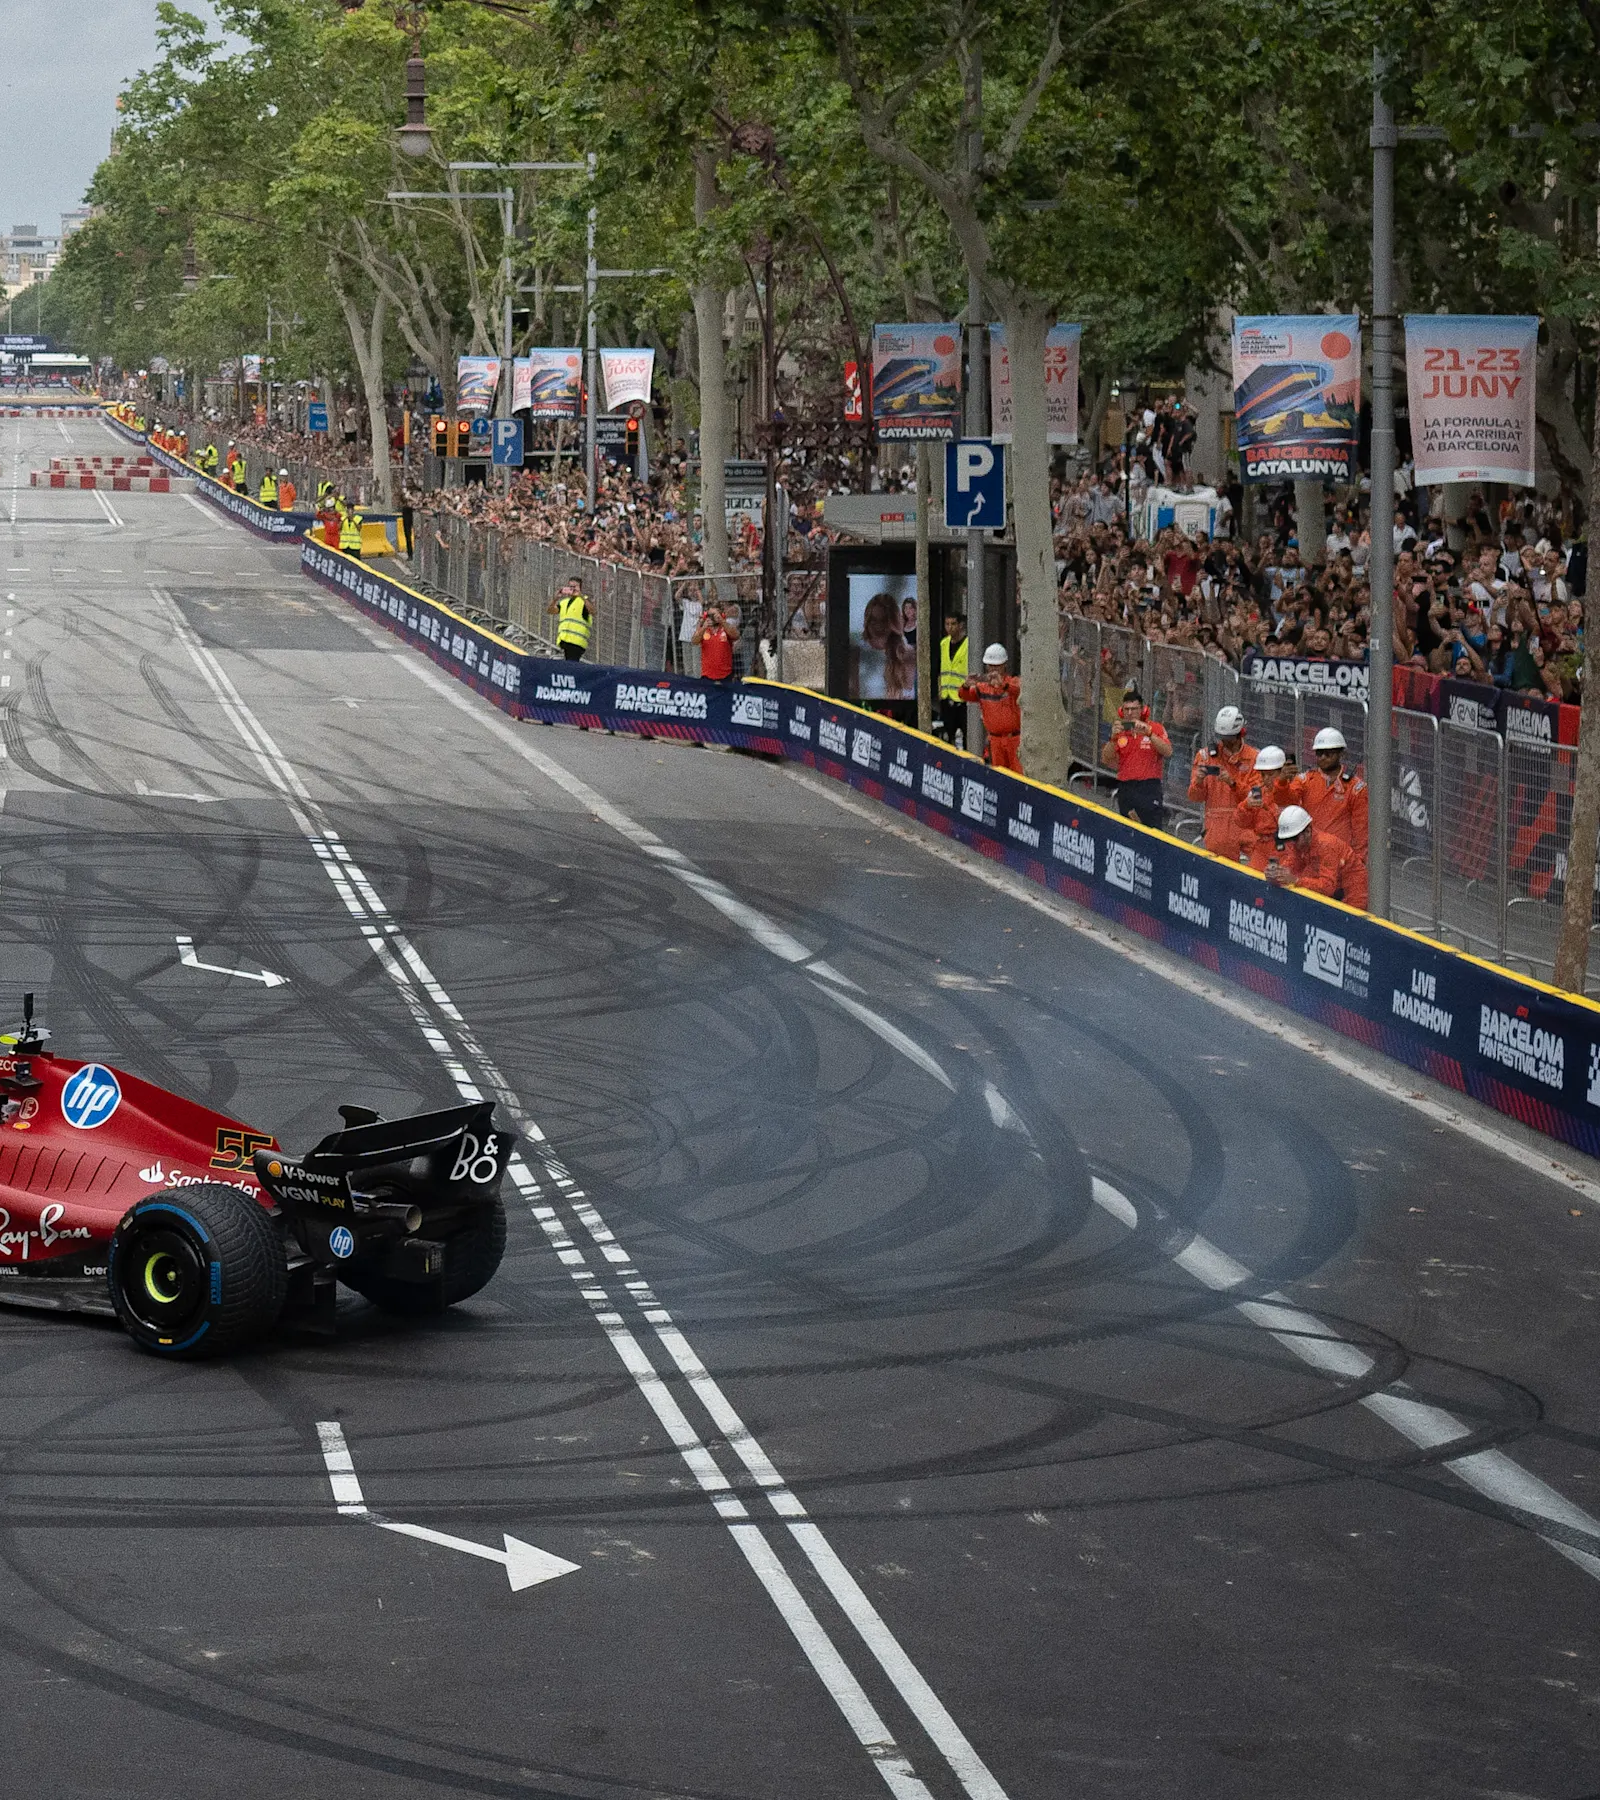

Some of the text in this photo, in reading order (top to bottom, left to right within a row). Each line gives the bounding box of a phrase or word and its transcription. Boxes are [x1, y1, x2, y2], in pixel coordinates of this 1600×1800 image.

[609, 365, 647, 378] JUNY
[1423, 348, 1520, 371] 21-23
[1423, 375, 1522, 399] JUNY
[533, 408, 575, 418] CATALUNYA
[878, 416, 953, 428] BARCELONA
[1424, 419, 1440, 428] LA
[1444, 418, 1512, 429] FORMULA
[498, 421, 518, 445] P
[878, 427, 954, 439] CATALUNYA
[1423, 429, 1522, 441] JA HA ARRIBAT
[1245, 446, 1349, 463] BARCELONA
[1426, 440, 1520, 454] A BARCELONA
[957, 444, 994, 492] P
[1246, 459, 1349, 477] CATALUNYA
[551, 673, 577, 689] LIVE
[1252, 658, 1370, 689] BARCELON
[535, 685, 592, 705] ROADSHOW
[616, 684, 708, 709] BARCELONA
[615, 699, 708, 719] FAN FESTIVAL 2024
[1507, 705, 1552, 739] BARCELONA
[923, 764, 954, 796] BARCELONA
[1018, 801, 1032, 824] LIVE
[1008, 817, 1040, 849] ROADSHOW
[1053, 821, 1095, 858] BARCELONA
[1181, 872, 1199, 899] LIVE
[1168, 890, 1211, 928] ROADSHOW
[1229, 898, 1288, 946] BARCELONA
[1229, 923, 1288, 964] FAN FESTIVAL 2024
[1411, 968, 1436, 1001] LIVE
[1392, 989, 1453, 1038] ROADSHOW
[1479, 1003, 1564, 1069] BARCELONA
[1478, 1033, 1564, 1091] FAN FESTIVAL 2024
[67, 1065, 116, 1128] hp
[209, 1127, 273, 1175] 55
[282, 1166, 340, 1187] V-Power
[273, 1184, 345, 1209] VGW PLAY
[334, 1227, 350, 1258] hp
